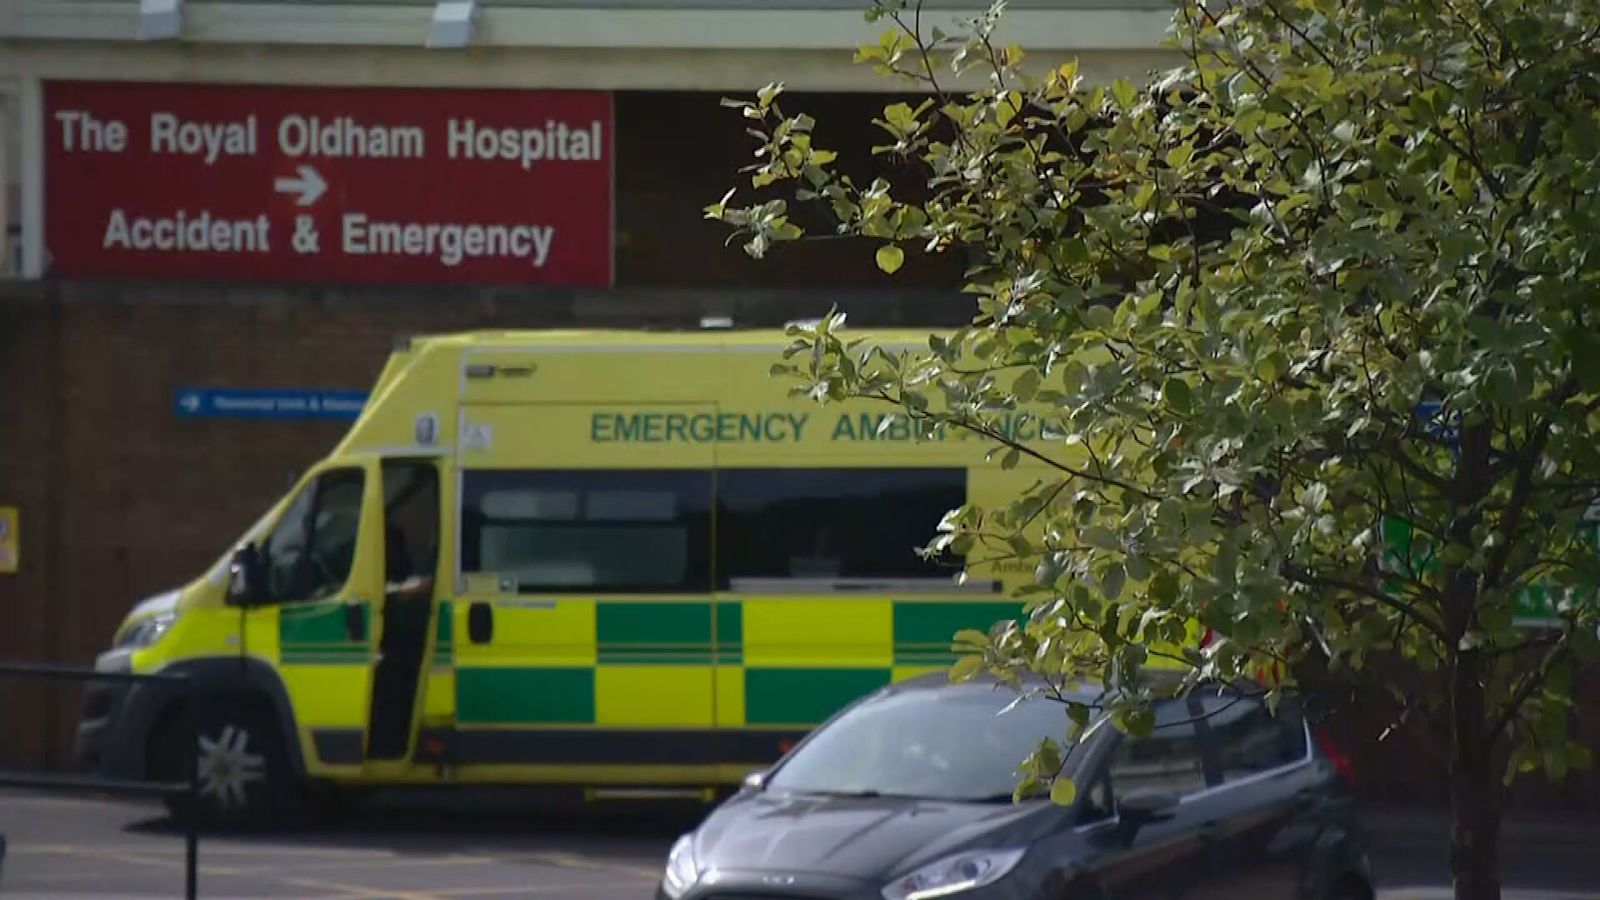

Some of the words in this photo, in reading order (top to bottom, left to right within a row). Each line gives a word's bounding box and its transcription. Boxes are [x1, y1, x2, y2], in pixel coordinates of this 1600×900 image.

[56, 111, 126, 152] The
[150, 114, 257, 163] Royal
[277, 115, 425, 158] Oldham
[447, 119, 602, 169] Hospital
[103, 210, 270, 252] Accident
[292, 215, 319, 253] &
[341, 214, 553, 266] Emergency
[590, 412, 809, 442] EMERGENCY
[832, 411, 1062, 442] AMBNC
